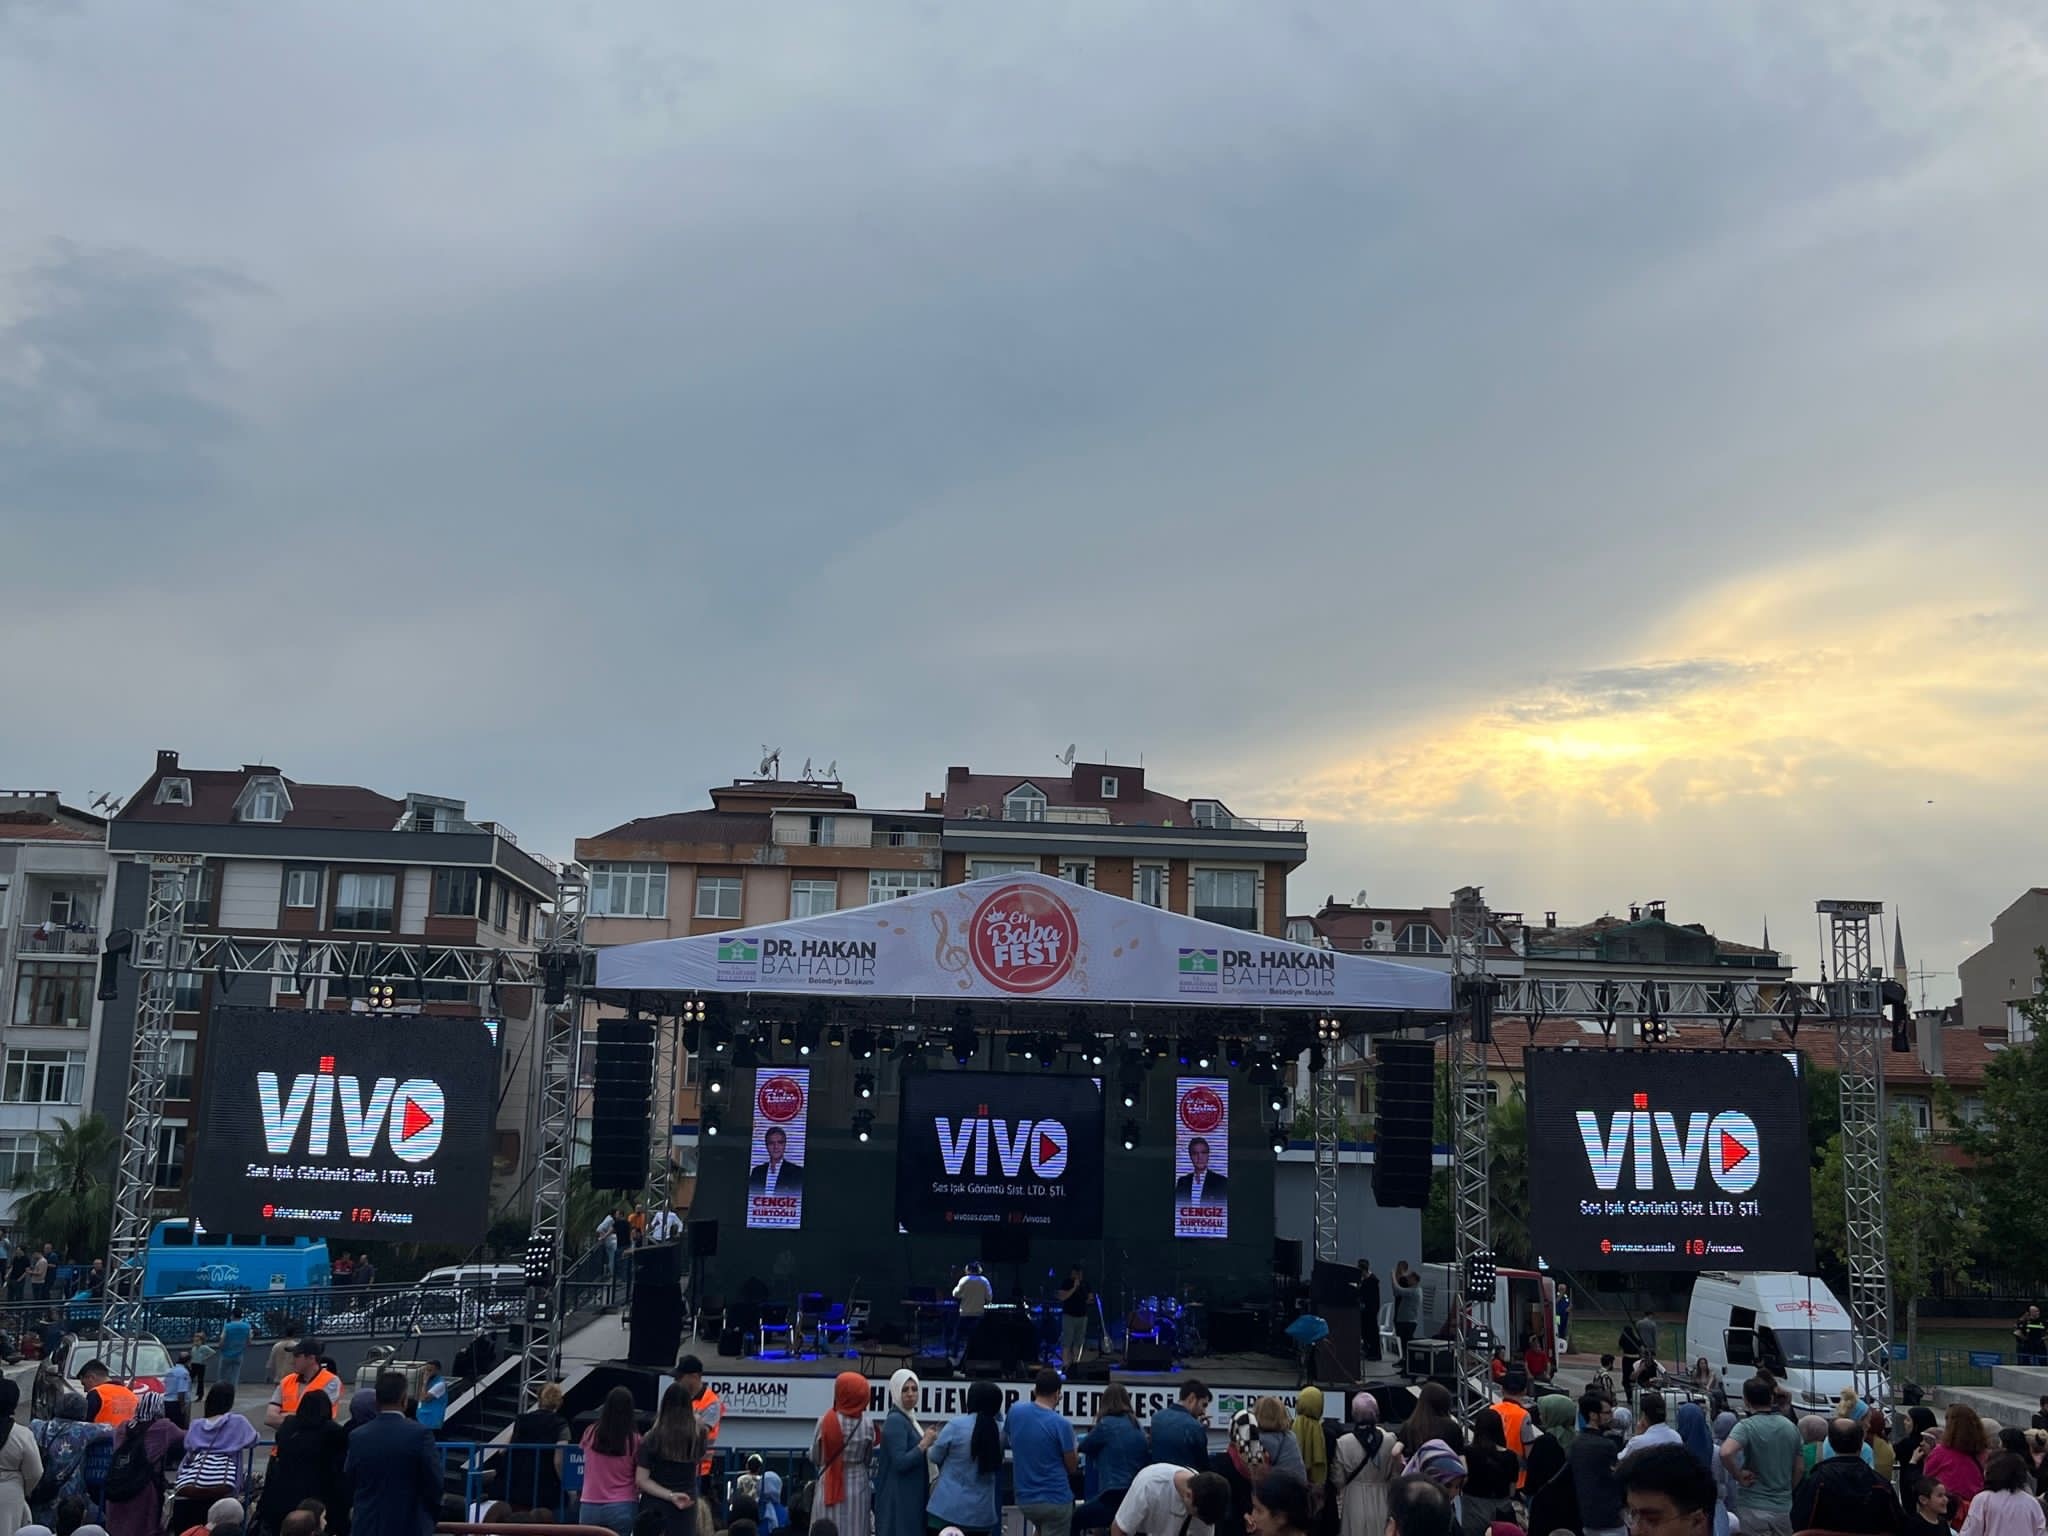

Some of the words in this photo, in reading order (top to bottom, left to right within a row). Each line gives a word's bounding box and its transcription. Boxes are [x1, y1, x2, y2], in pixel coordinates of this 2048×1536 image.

[987, 919, 1063, 946] Baba
[763, 939, 796, 957] DR.
[801, 940, 877, 959] HAKAN
[994, 941, 1060, 968] FEST
[761, 956, 876, 977] BAHADIR
[1223, 950, 1256, 968] DR.
[1261, 951, 1335, 969] HAKAN
[1223, 967, 1335, 987] BAHADIR
[712, 1382, 734, 1394] DR.
[737, 1383, 788, 1396] HAKAN
[723, 1394, 788, 1408] AHADIR
